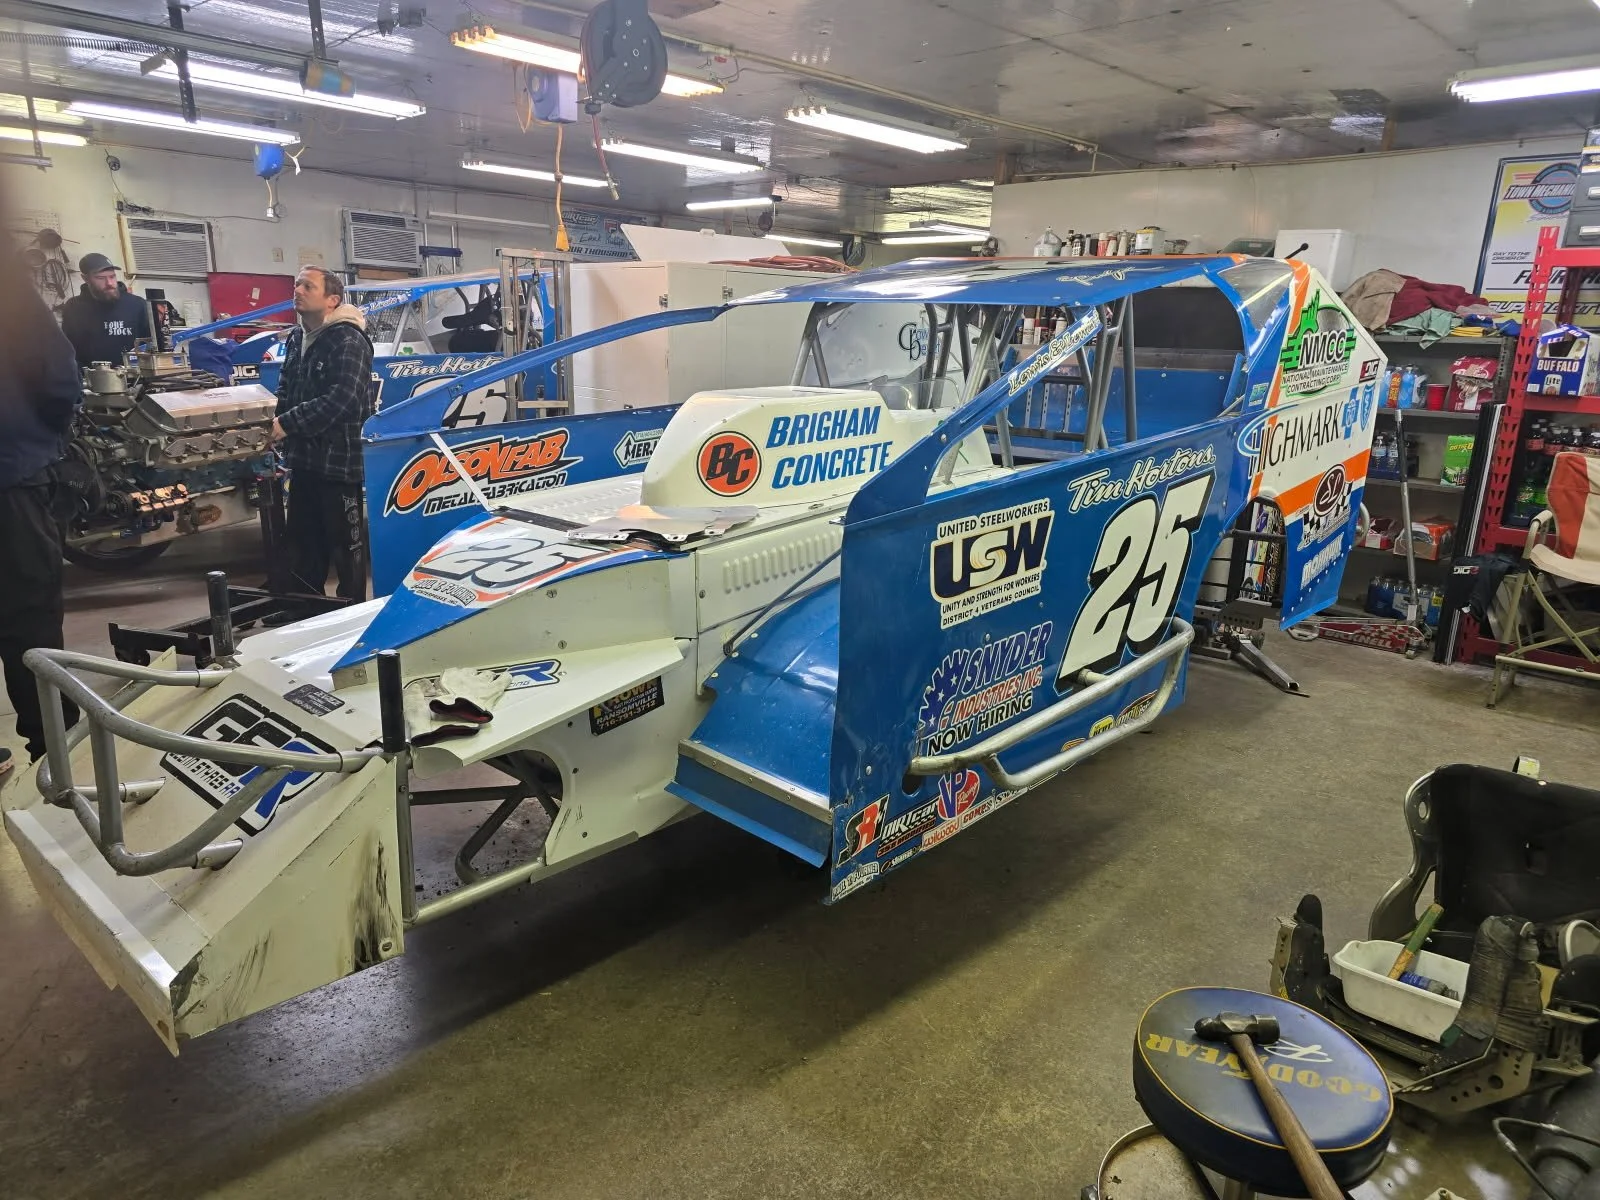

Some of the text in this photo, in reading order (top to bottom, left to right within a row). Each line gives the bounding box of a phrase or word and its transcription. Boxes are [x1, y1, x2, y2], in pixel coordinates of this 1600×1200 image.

[387, 361, 437, 378] Tim
[1299, 330, 1347, 367] NMCC
[1537, 360, 1580, 373] BUFFALO
[1008, 352, 1051, 397] Lewis
[1282, 363, 1348, 385] NATIONAL MAINTENANCE
[1287, 379, 1325, 394] CONTRACTING
[766, 405, 881, 449] BRIGHAM
[1248, 400, 1344, 479] HIGHMARK
[706, 442, 755, 486] BC
[772, 440, 893, 490] CONCRETE
[1069, 468, 1123, 512] Tim
[939, 501, 1049, 538] UNITED STEELWORKERS
[414, 537, 614, 588] 25
[933, 515, 1053, 600] USW
[942, 572, 1040, 614] UNITY AND STRENGTH FOR WORKERS
[1055, 470, 1215, 692] 25
[943, 585, 1041, 627] DISTRICT 4 VETERANS COUNCIL
[961, 620, 1053, 694] SNYDER
[596, 691, 658, 725] RANSOMVILLE
[951, 673, 1022, 727] INDUSTRIES
[927, 690, 1033, 757] NOW HIRING
[190, 757, 230, 790] STYRES
[938, 767, 968, 819] VP
[881, 801, 938, 841] DIRTcar
